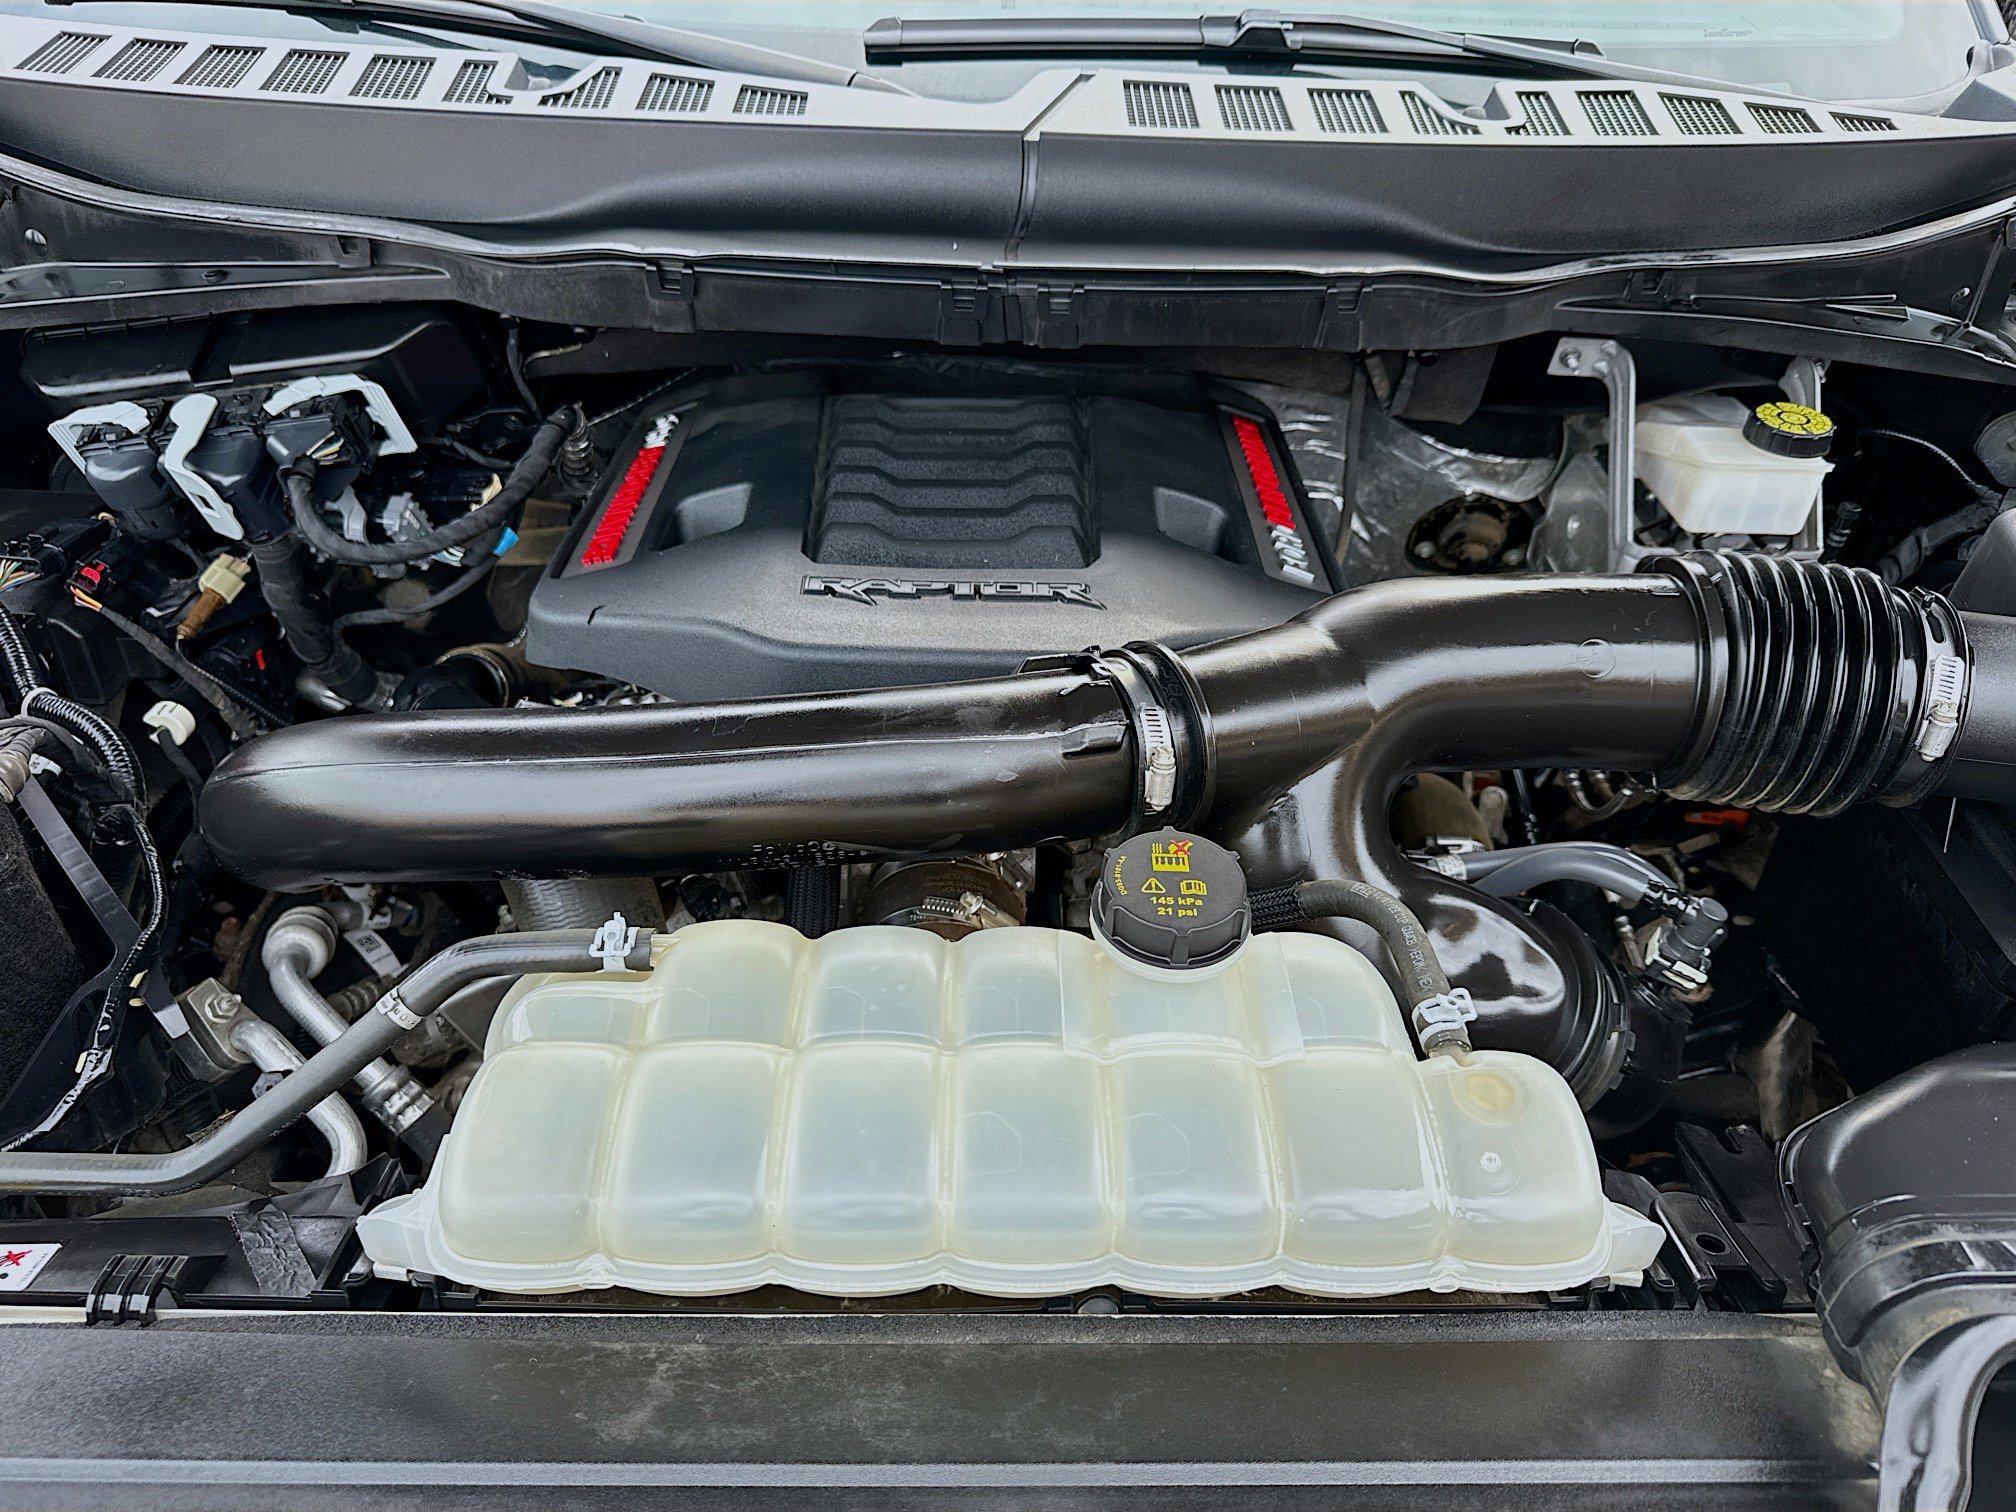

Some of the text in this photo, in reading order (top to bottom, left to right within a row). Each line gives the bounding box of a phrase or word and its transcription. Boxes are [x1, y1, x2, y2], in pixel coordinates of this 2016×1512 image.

[800, 574, 1107, 611] RAPTOR
[1151, 896, 1203, 906] 145 kPa
[1158, 907, 1198, 917] 21 psi
